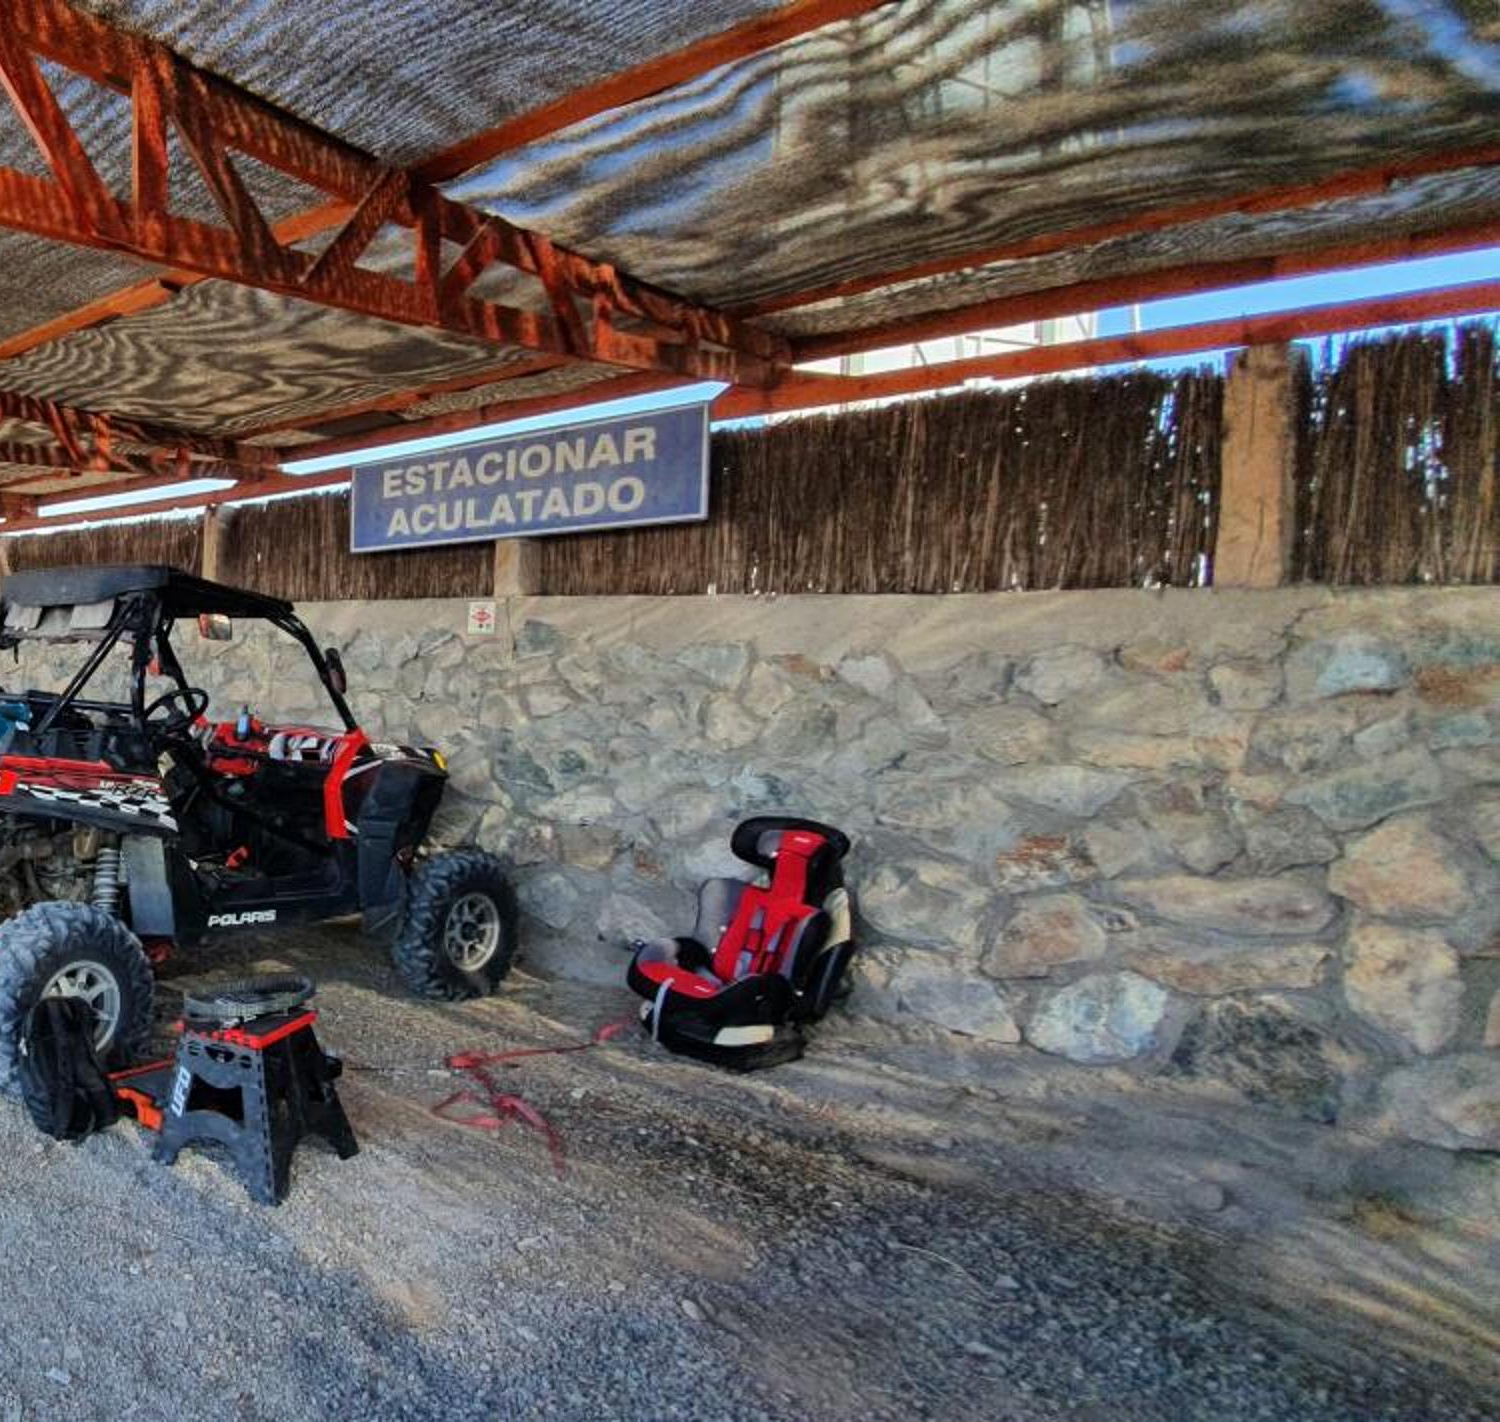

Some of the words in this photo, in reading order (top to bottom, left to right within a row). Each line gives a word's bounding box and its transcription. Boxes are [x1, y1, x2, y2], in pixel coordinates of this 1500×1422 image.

[383, 427, 656, 499] ESTACIONAR
[387, 476, 646, 537] ACULATADO
[207, 909, 277, 927] POLARIS
[171, 1066, 191, 1118] UFO
